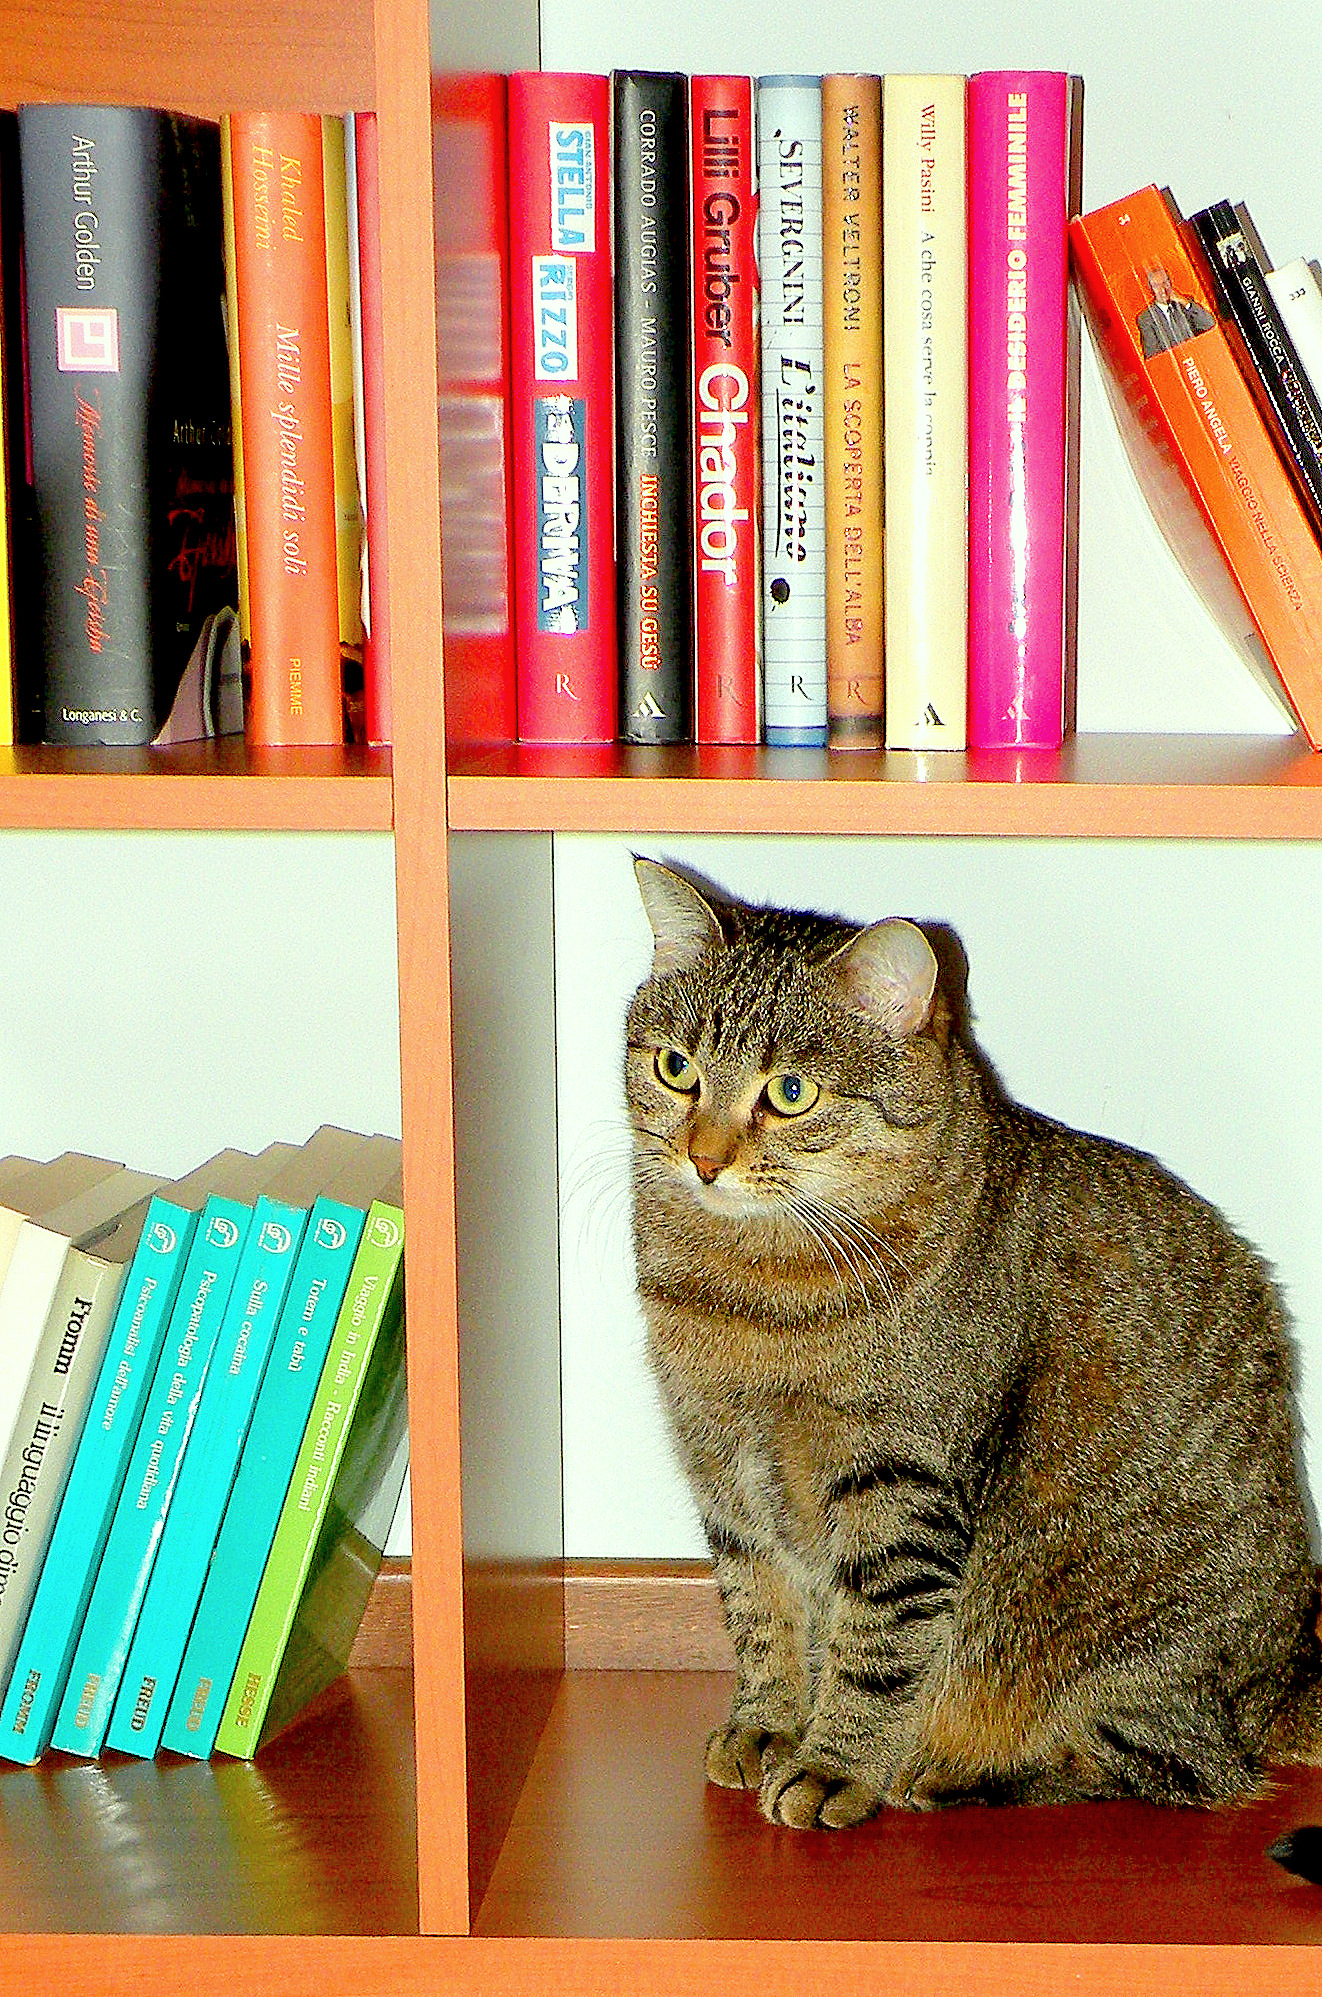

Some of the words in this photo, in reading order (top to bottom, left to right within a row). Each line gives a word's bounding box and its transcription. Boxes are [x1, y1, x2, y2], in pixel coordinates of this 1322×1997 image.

[639, 108, 657, 208] CORRADO
[702, 108, 741, 179] Lilli
[842, 105, 861, 201] WALTER
[916, 103, 937, 152] Willy
[71, 134, 98, 205] Arthur
[251, 143, 277, 251] Hosseini
[278, 152, 304, 243] Khaled
[555, 130, 585, 246] STELLA
[585, 160, 594, 210] ANTONIO
[919, 157, 936, 214] Pasini
[1006, 91, 1029, 242] FEMMINILE
[74, 211, 102, 292] Golden
[639, 214, 658, 295] AUGIAS
[779, 139, 804, 327] SEVERGNINI
[920, 231, 936, 244] A
[920, 248, 937, 283] che
[703, 192, 741, 350] Gruber
[842, 212, 861, 331] VELTRONI
[539, 264, 568, 374] RIZZO
[920, 288, 935, 331] cosa
[1006, 248, 1029, 391] DESIDERIO
[1242, 276, 1268, 326] GIANNI
[1261, 322, 1286, 364] ROCCA
[275, 322, 302, 395] Mille
[639, 316, 658, 392] MAURO
[843, 363, 861, 391] LA
[920, 336, 935, 385] serve
[640, 398, 658, 458] PESCE
[1006, 396, 1029, 423] IL
[270, 401, 306, 522] splendidi
[698, 363, 750, 589] Chador
[779, 353, 816, 563] L'italiano
[843, 399, 863, 518] SCOPERTA
[1182, 357, 1209, 399] PIERO
[1200, 398, 1234, 455] ANGELA
[1228, 456, 1258, 517] VIAGGIO
[1251, 515, 1278, 555] NELLA
[1271, 553, 1303, 611] SCIENZA
[282, 529, 308, 576] soli
[540, 441, 580, 613] DERIVA
[640, 473, 661, 579] INCHIESTA
[73, 569, 111, 655] Geisha
[640, 584, 659, 613] SU
[843, 525, 863, 647] DELL'ALBA
[640, 617, 663, 671] GESÙ
[61, 705, 117, 727] Longanesi
[119, 708, 129, 722] &
[288, 657, 303, 716] PIEMME
[123, 1276, 159, 1359] Psicoanalisi
[176, 1269, 219, 1369] Psicopatologia
[245, 1279, 269, 1317] Sulla
[297, 1325, 308, 1335] e
[300, 1278, 328, 1322] Totem
[351, 1275, 380, 1327] Viaggio
[53, 1296, 93, 1376] Fromm
[227, 1320, 255, 1376] cocaina
[287, 1338, 308, 1373] tabù
[334, 1346, 357, 1385] India
[344, 1330, 358, 1345] in
[101, 1359, 135, 1432] dell'amore
[157, 1409, 174, 1436] vita
[166, 1371, 187, 1406] della
[310, 1400, 342, 1464] Racconti
[134, 1437, 166, 1511] quotidiana
[298, 1464, 320, 1512] indiani
[12, 1669, 42, 1734] FROMM
[130, 1675, 157, 1733] FREUD
[234, 1672, 262, 1729] HESSE
